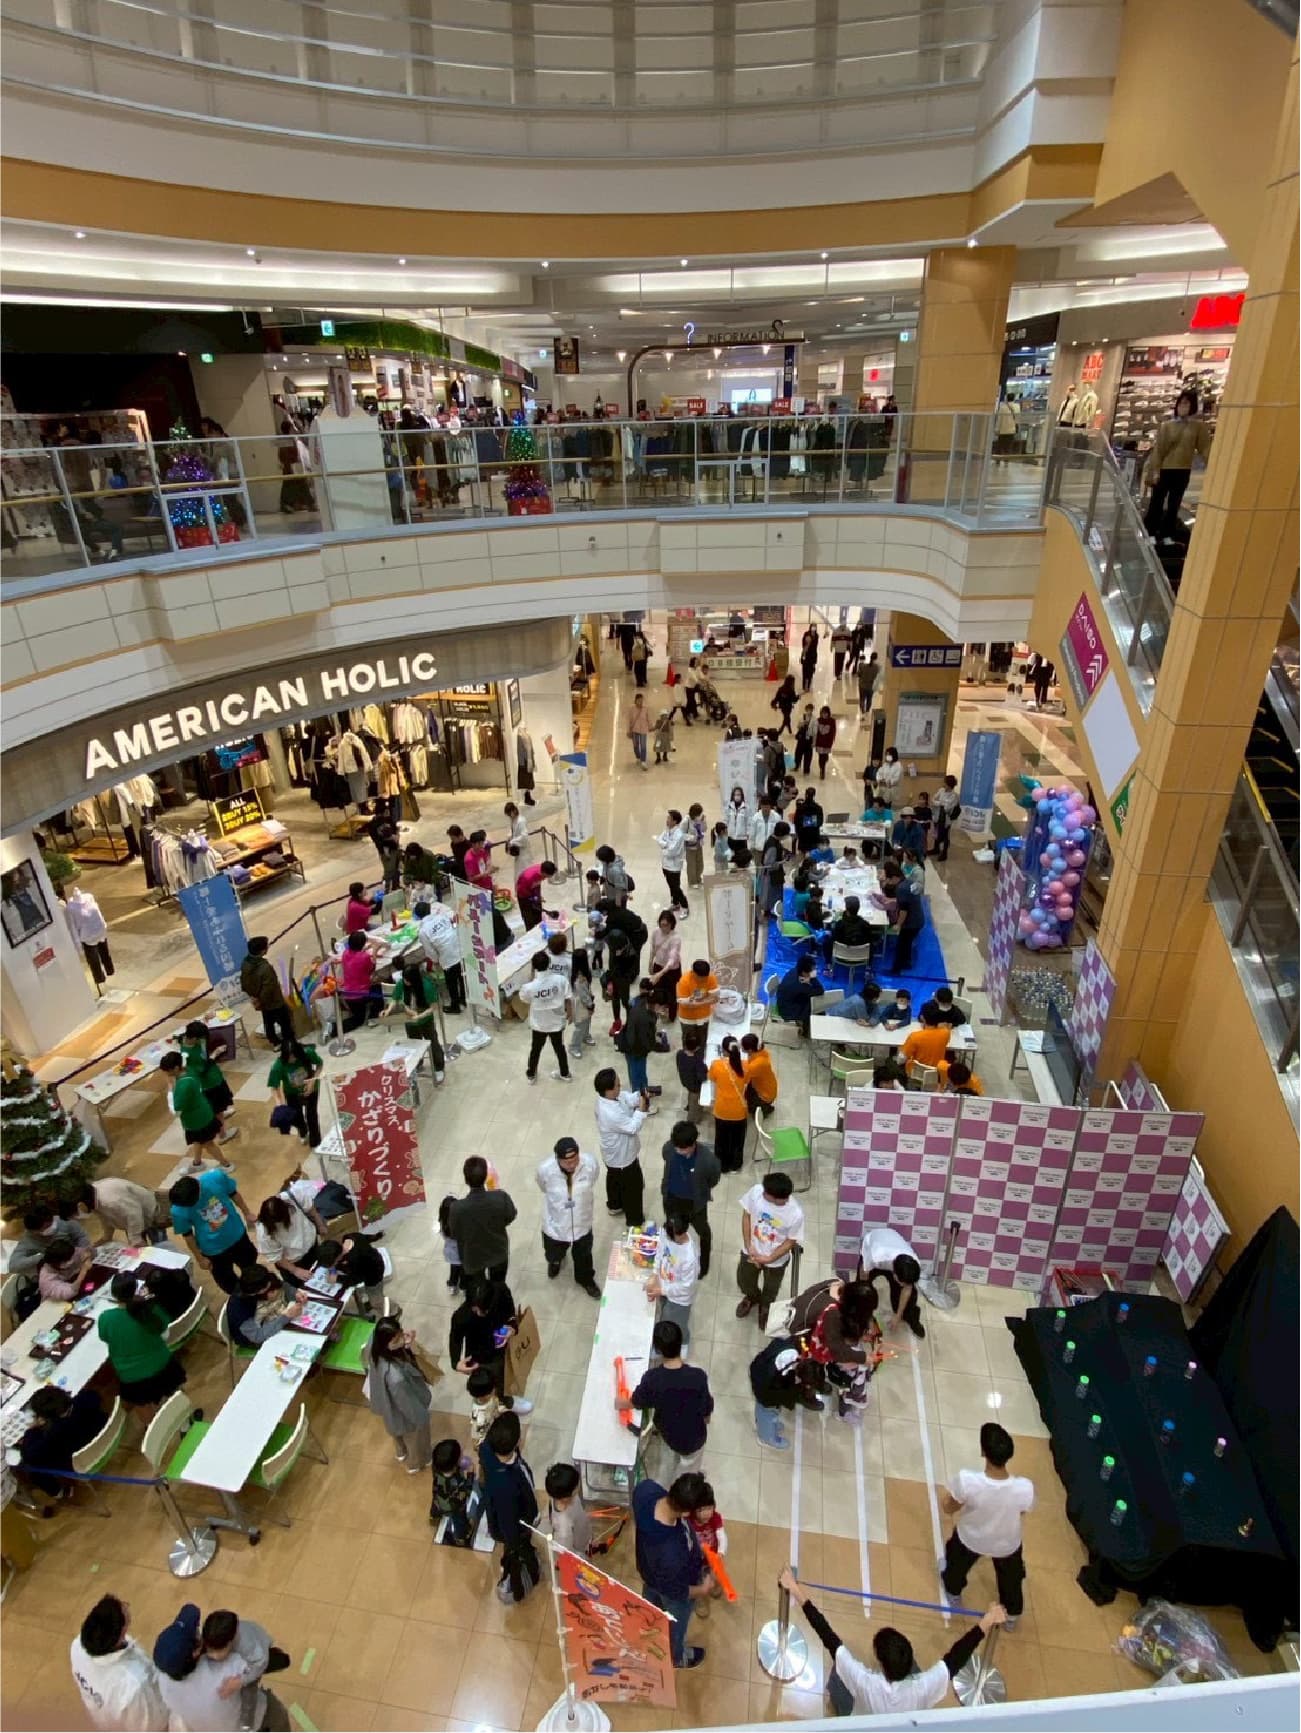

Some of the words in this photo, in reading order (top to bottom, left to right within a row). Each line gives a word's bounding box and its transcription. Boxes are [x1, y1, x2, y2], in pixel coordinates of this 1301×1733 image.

[708, 330, 784, 344] INFORMATION
[688, 401, 704, 409] SALE
[774, 401, 789, 409] SALE
[85, 677, 309, 780] AMERICAN
[320, 652, 437, 700] HOLIC
[534, 988, 551, 998] JCI
[381, 1075, 400, 1126] クリスマス
[357, 1090, 392, 1200] かざりづくり
